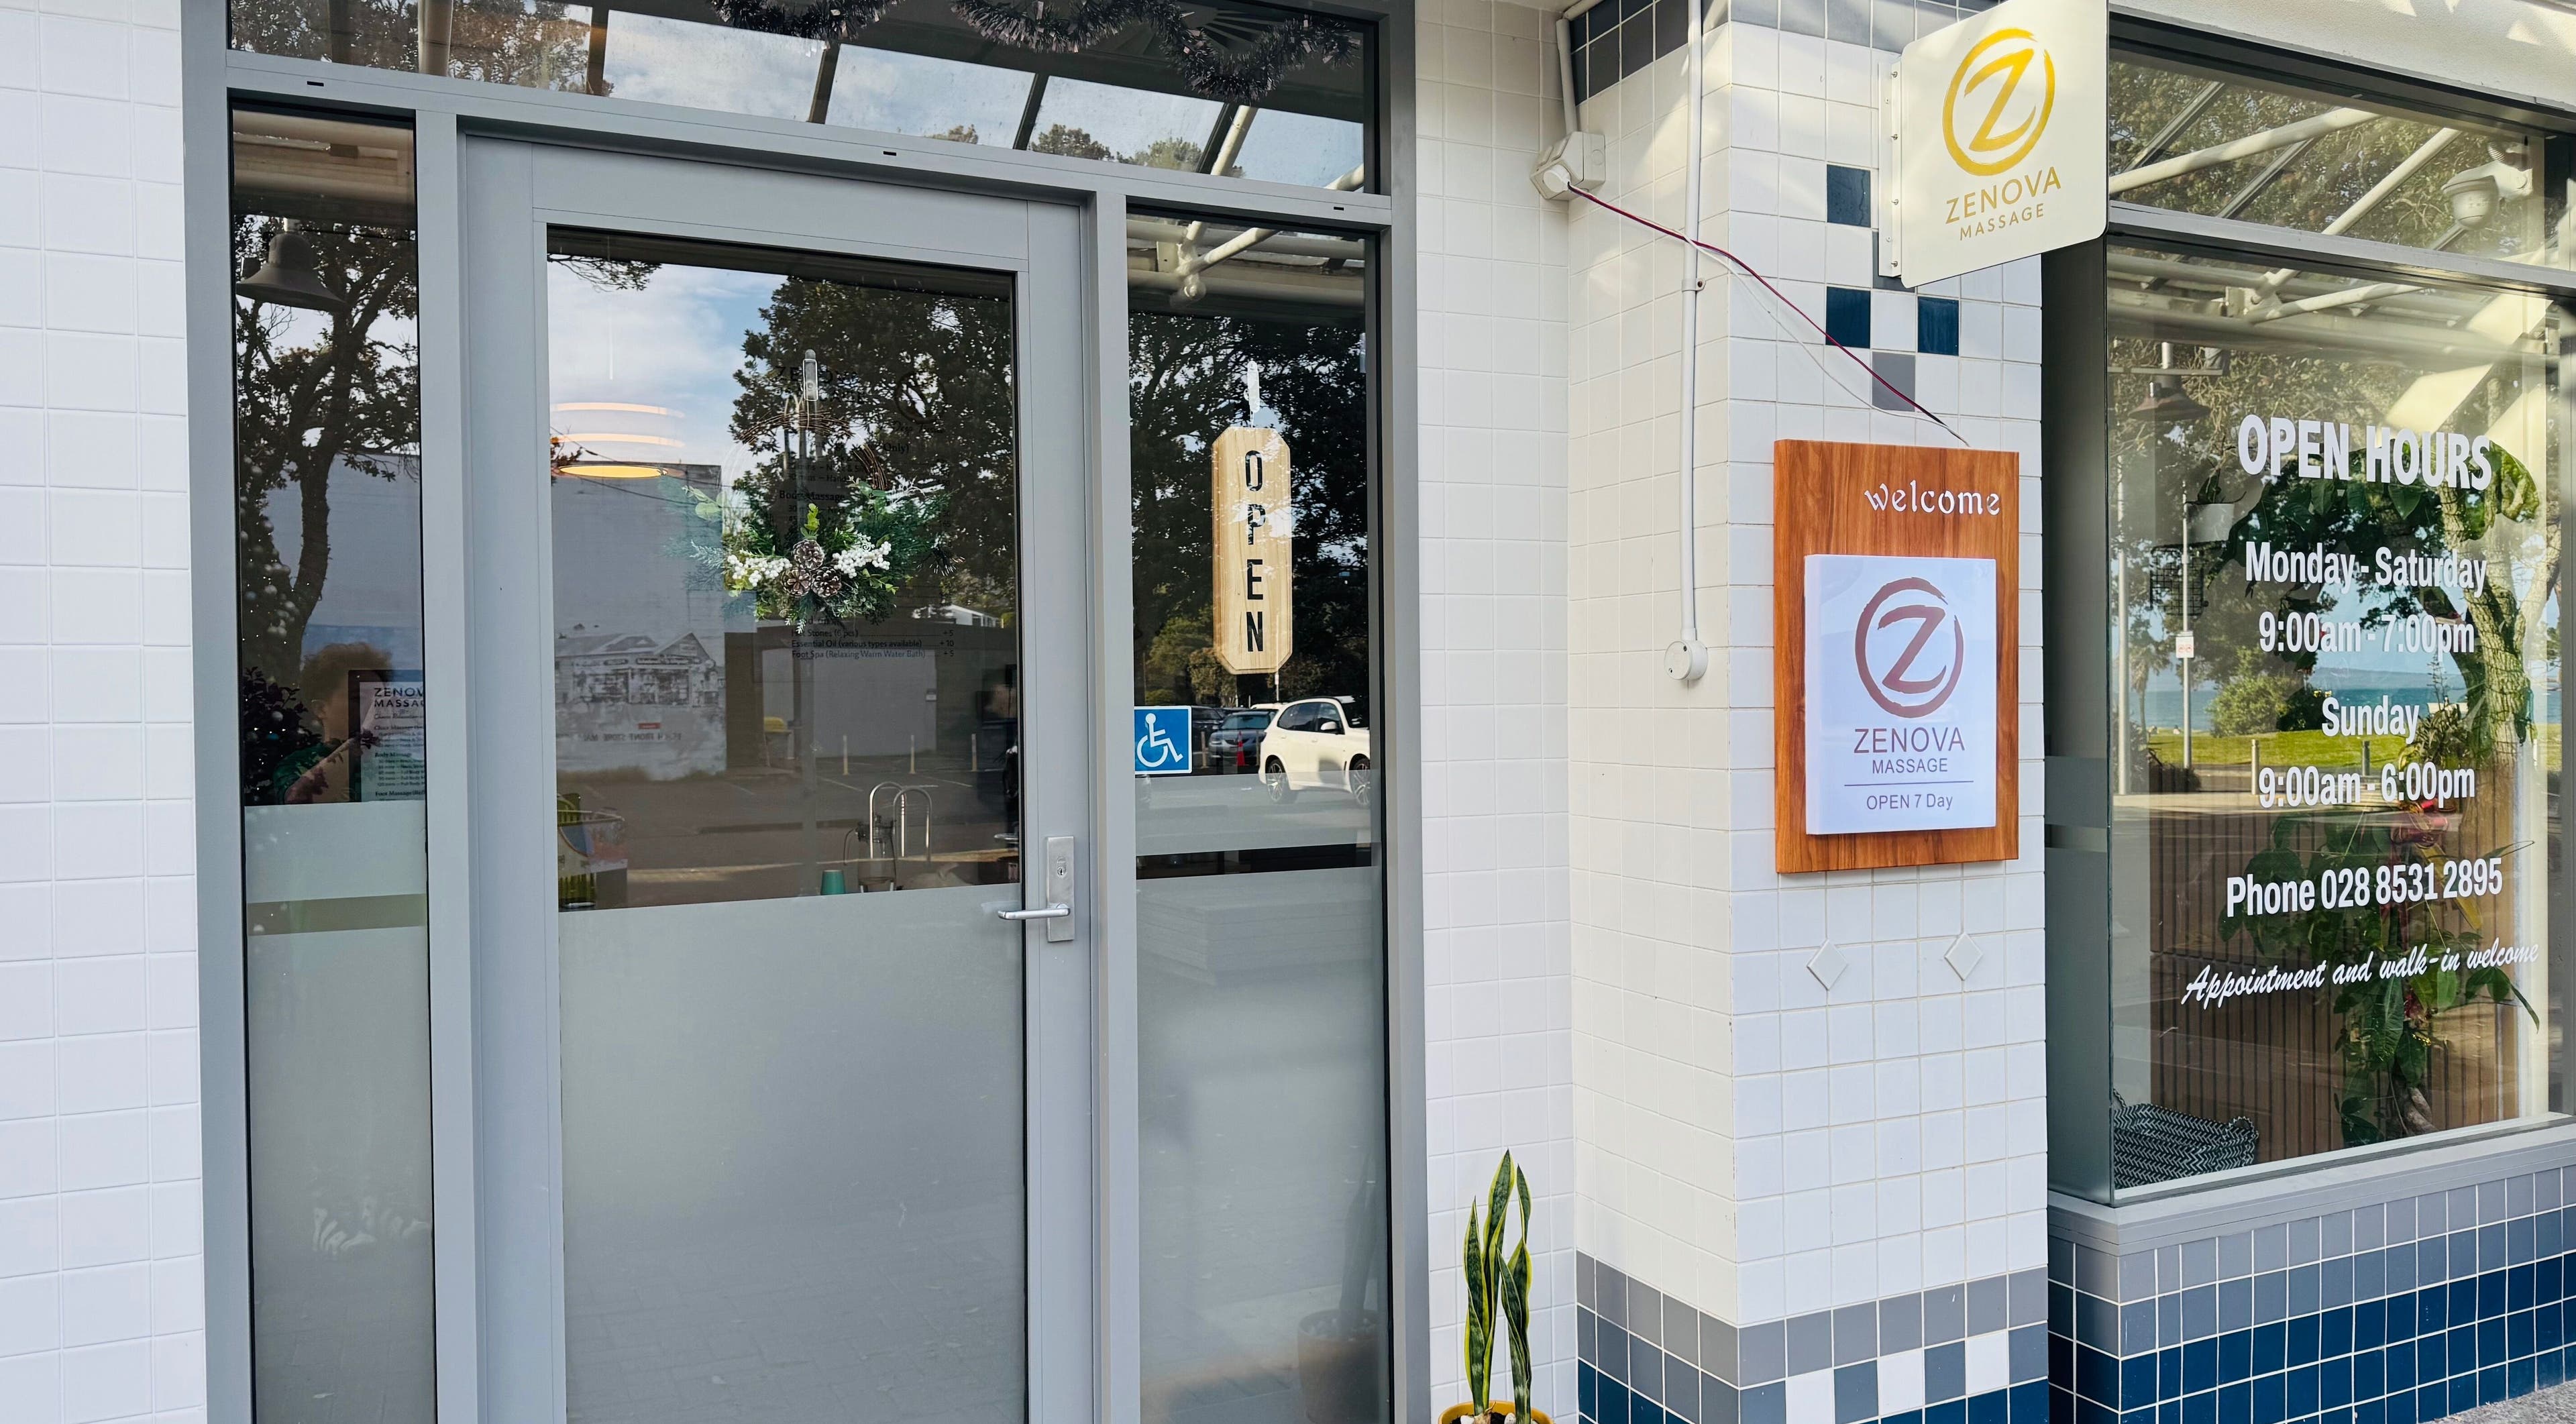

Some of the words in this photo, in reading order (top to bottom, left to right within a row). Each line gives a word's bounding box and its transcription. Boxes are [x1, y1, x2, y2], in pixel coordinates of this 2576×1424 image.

[1945, 166, 2061, 225] ZENOVA
[1960, 203, 2045, 241] MASSAGE
[2237, 414, 2350, 482] OPEN
[2365, 425, 2493, 491] HOURS
[780, 490, 805, 500] Bod
[1864, 479, 2002, 516] welcome
[1244, 449, 1266, 653] OPEN
[2245, 541, 2355, 596] Monday
[2360, 565, 2369, 573] -
[2375, 546, 2487, 598] Saturday
[810, 650, 824, 659] Spa
[826, 650, 859, 659] (Relaxing
[907, 650, 926, 659] Bath)
[839, 640, 867, 649] (various
[869, 641, 887, 649] types
[889, 640, 922, 648] available)
[2258, 610, 2361, 654] 9:00am
[2367, 634, 2377, 642] -
[2381, 613, 2475, 661] 7:00pm
[374, 687, 423, 698] ZENOV
[374, 699, 424, 708] MASSA
[2321, 694, 2420, 744] Sunday
[1854, 726, 1966, 755] ZENOVA
[1871, 757, 1949, 775] MASSAGE
[2257, 765, 2361, 808] 9:00am
[2367, 782, 2376, 791] -
[2380, 761, 2475, 809] 6:00pm
[1866, 793, 1911, 811] OPEN
[1914, 793, 1923, 809] 7
[1926, 793, 1953, 812] Day
[2226, 872, 2316, 918] Phone
[2321, 866, 2371, 910] 028
[2375, 863, 2438, 906] 8531
[2443, 857, 2504, 900] 2895
[2180, 959, 2328, 1010] Appointment
[2332, 951, 2375, 984] and
[2379, 942, 2462, 981] walk-in
[2467, 936, 2540, 971] welcome
